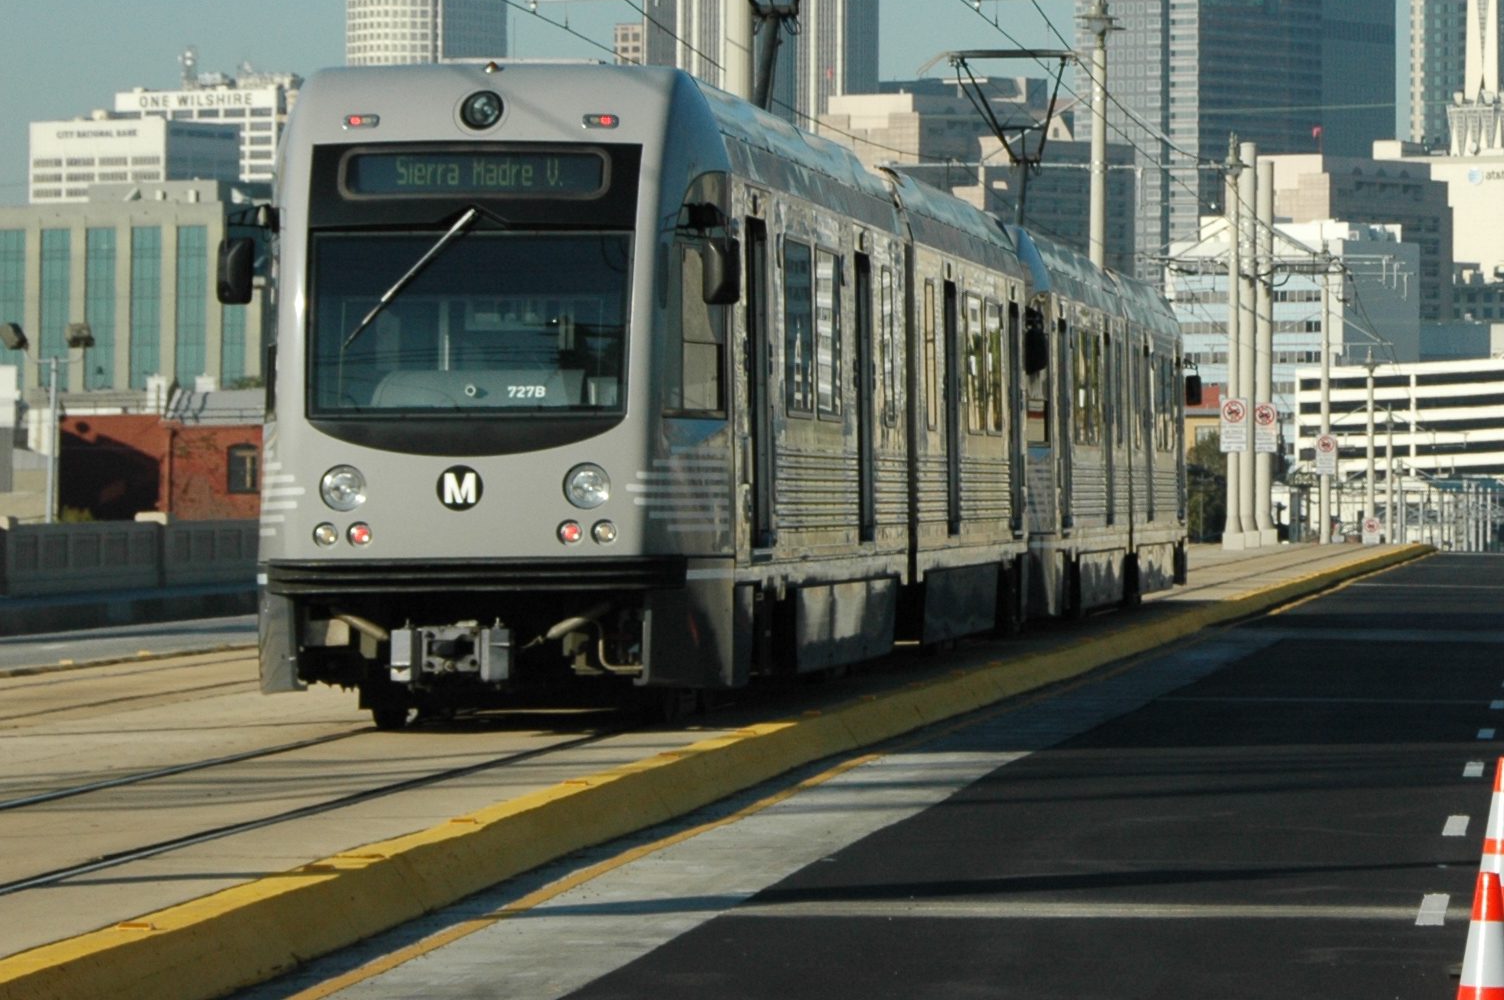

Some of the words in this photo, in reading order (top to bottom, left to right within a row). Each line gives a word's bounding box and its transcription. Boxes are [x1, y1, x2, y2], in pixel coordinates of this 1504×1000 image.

[139, 95, 169, 108] ONE
[177, 93, 252, 107] WILSHIRE
[396, 156, 459, 186] Sierra
[473, 157, 533, 187] Madre
[507, 385, 547, 399] 727B
[444, 472, 476, 504] M
